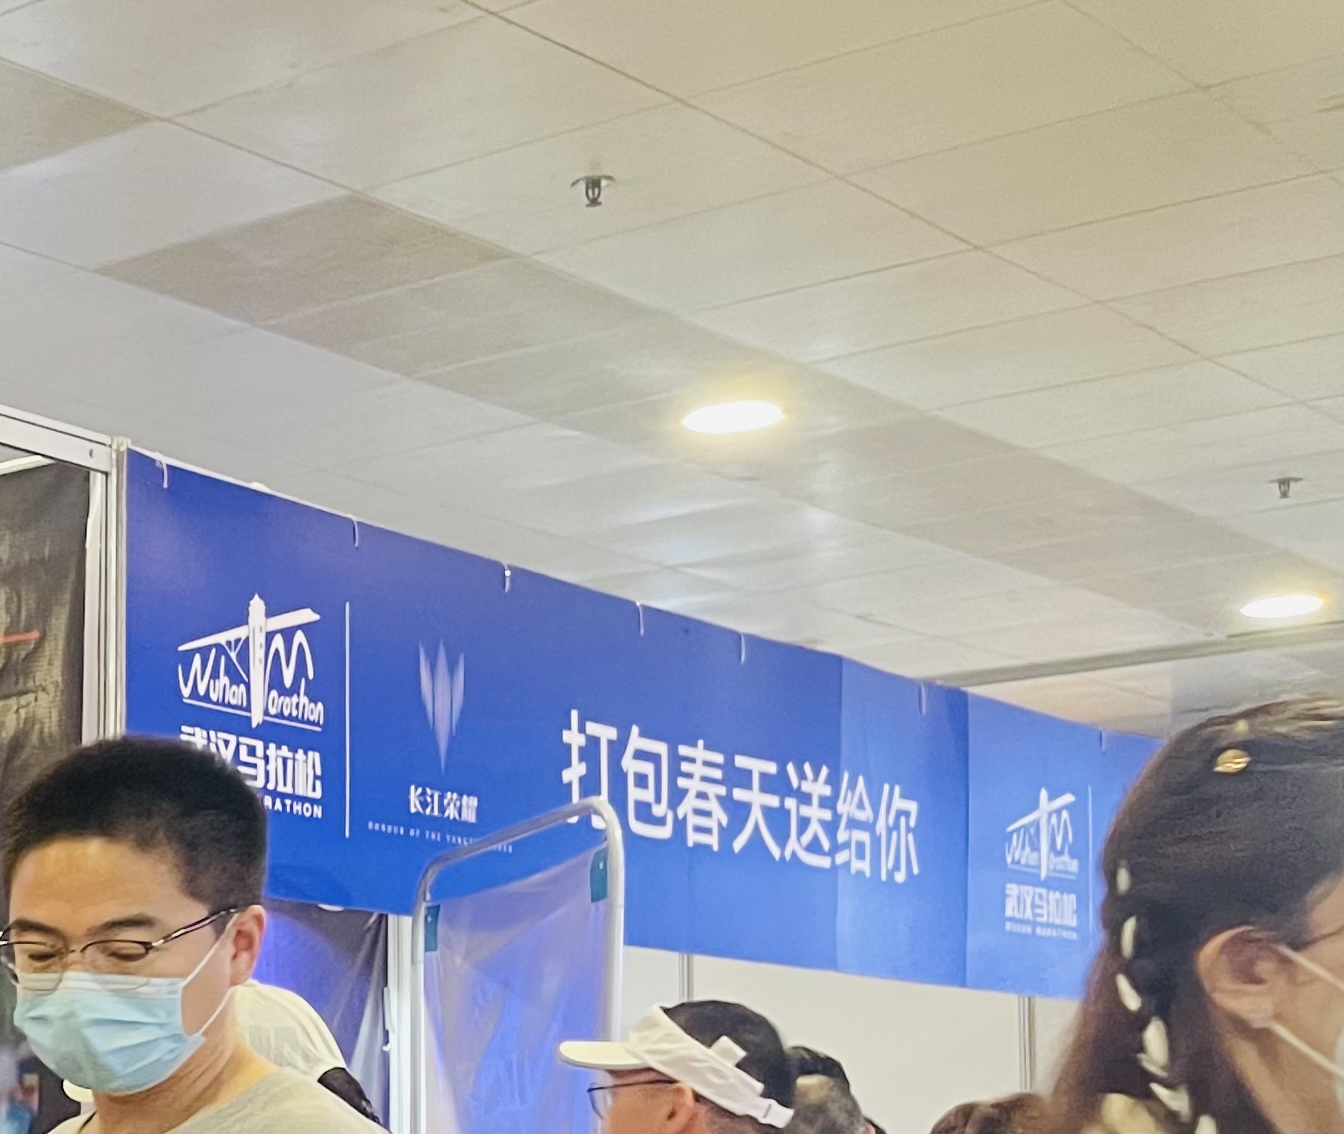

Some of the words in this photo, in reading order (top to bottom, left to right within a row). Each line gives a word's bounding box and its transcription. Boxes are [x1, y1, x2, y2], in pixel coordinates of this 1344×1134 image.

[178, 647, 247, 708] Wuhan
[409, 784, 478, 823] 长江荣耀
[561, 709, 920, 884] 打包春天送给你
